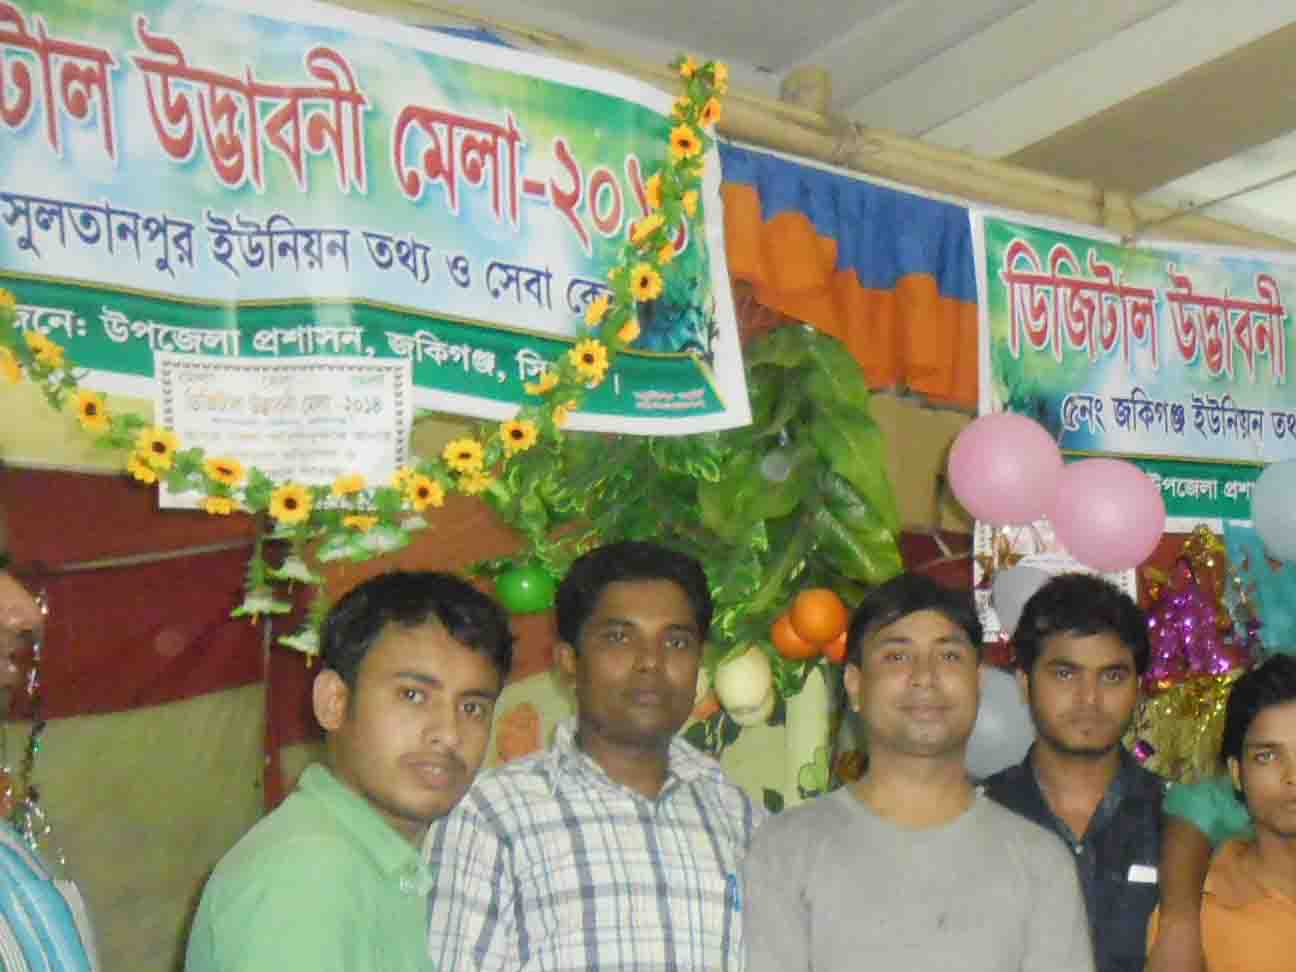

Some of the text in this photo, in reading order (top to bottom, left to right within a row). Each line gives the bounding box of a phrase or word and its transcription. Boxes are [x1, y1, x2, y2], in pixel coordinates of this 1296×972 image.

[131, 16, 370, 190] উদ্ভাবনী
[394, 104, 688, 250] মেলা-২০১
[0, 192, 196, 278] সুলতানপুর
[205, 211, 350, 278] ইউনিয়ন
[363, 230, 431, 284] তথ্য
[447, 254, 471, 289] ও
[486, 261, 553, 311] সেবা
[999, 238, 1158, 368] ডিজিটাল
[1165, 263, 1287, 380] উদ্ভাবনী
[99, 305, 241, 357] উপজেলা
[386, 329, 507, 384] জকিগঞ্জ,
[1112, 386, 1186, 434] জকিগঞ্জ
[1191, 391, 1265, 440] ইউনিয়ন
